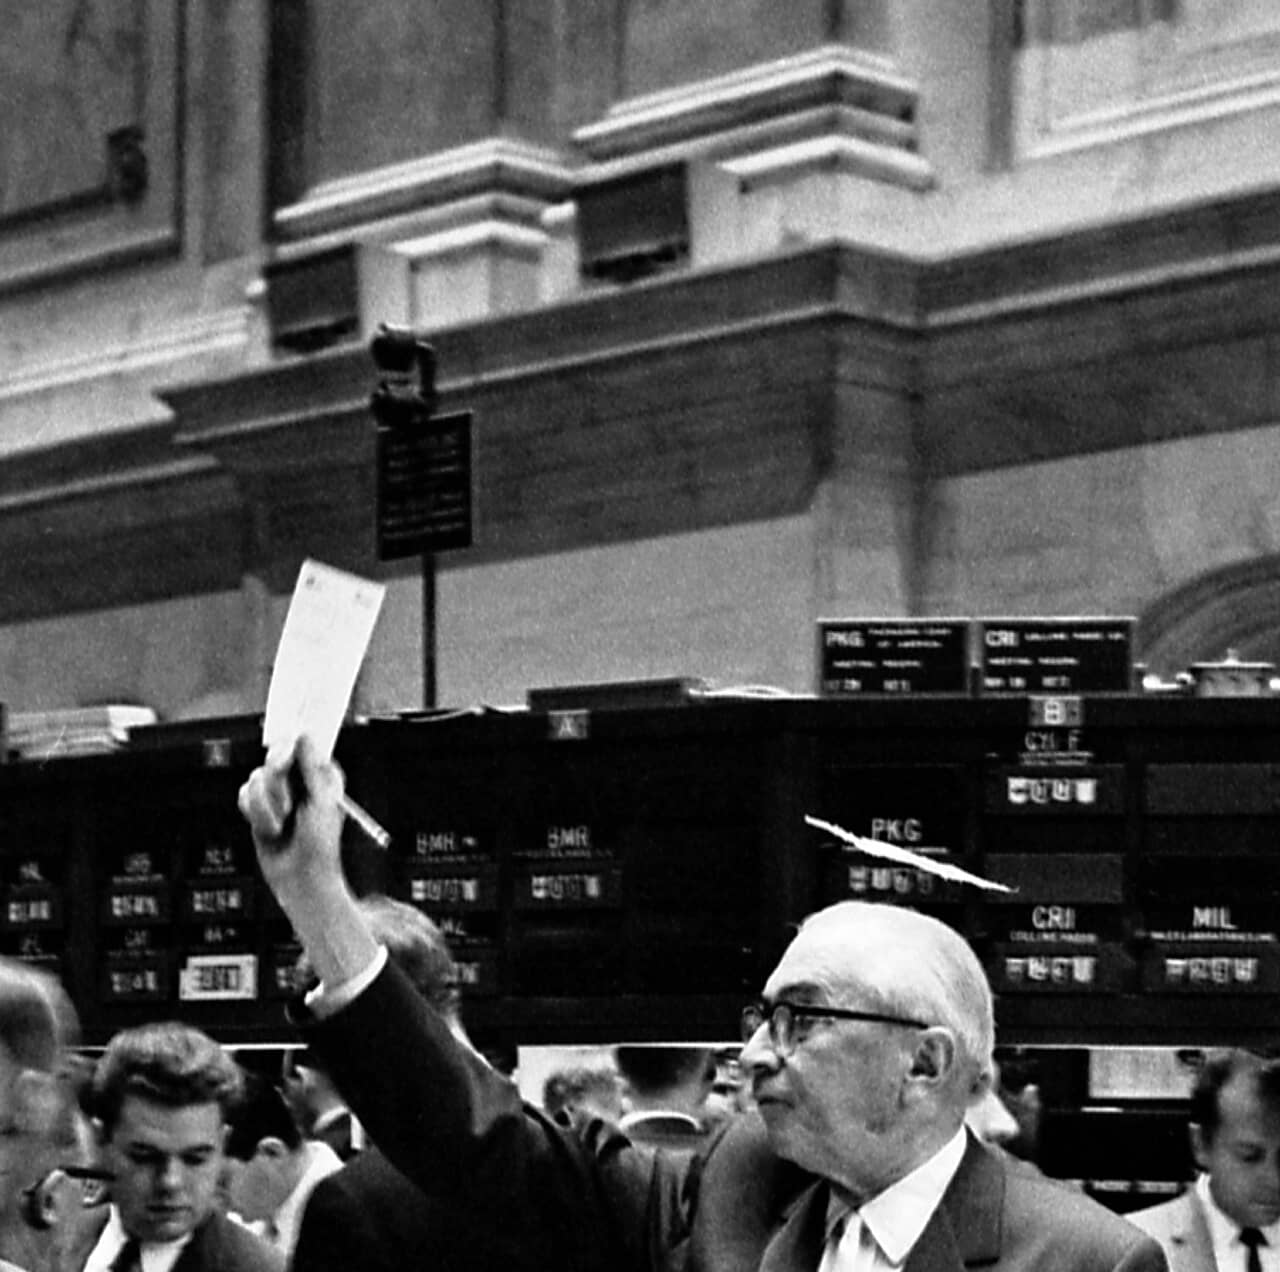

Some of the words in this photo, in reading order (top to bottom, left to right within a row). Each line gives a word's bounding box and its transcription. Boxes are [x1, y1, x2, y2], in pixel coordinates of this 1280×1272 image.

[826, 630, 865, 648] PKG
[872, 818, 922, 841] PKG
[1032, 905, 1076, 929] CRI
[1193, 906, 1238, 929] MIL
